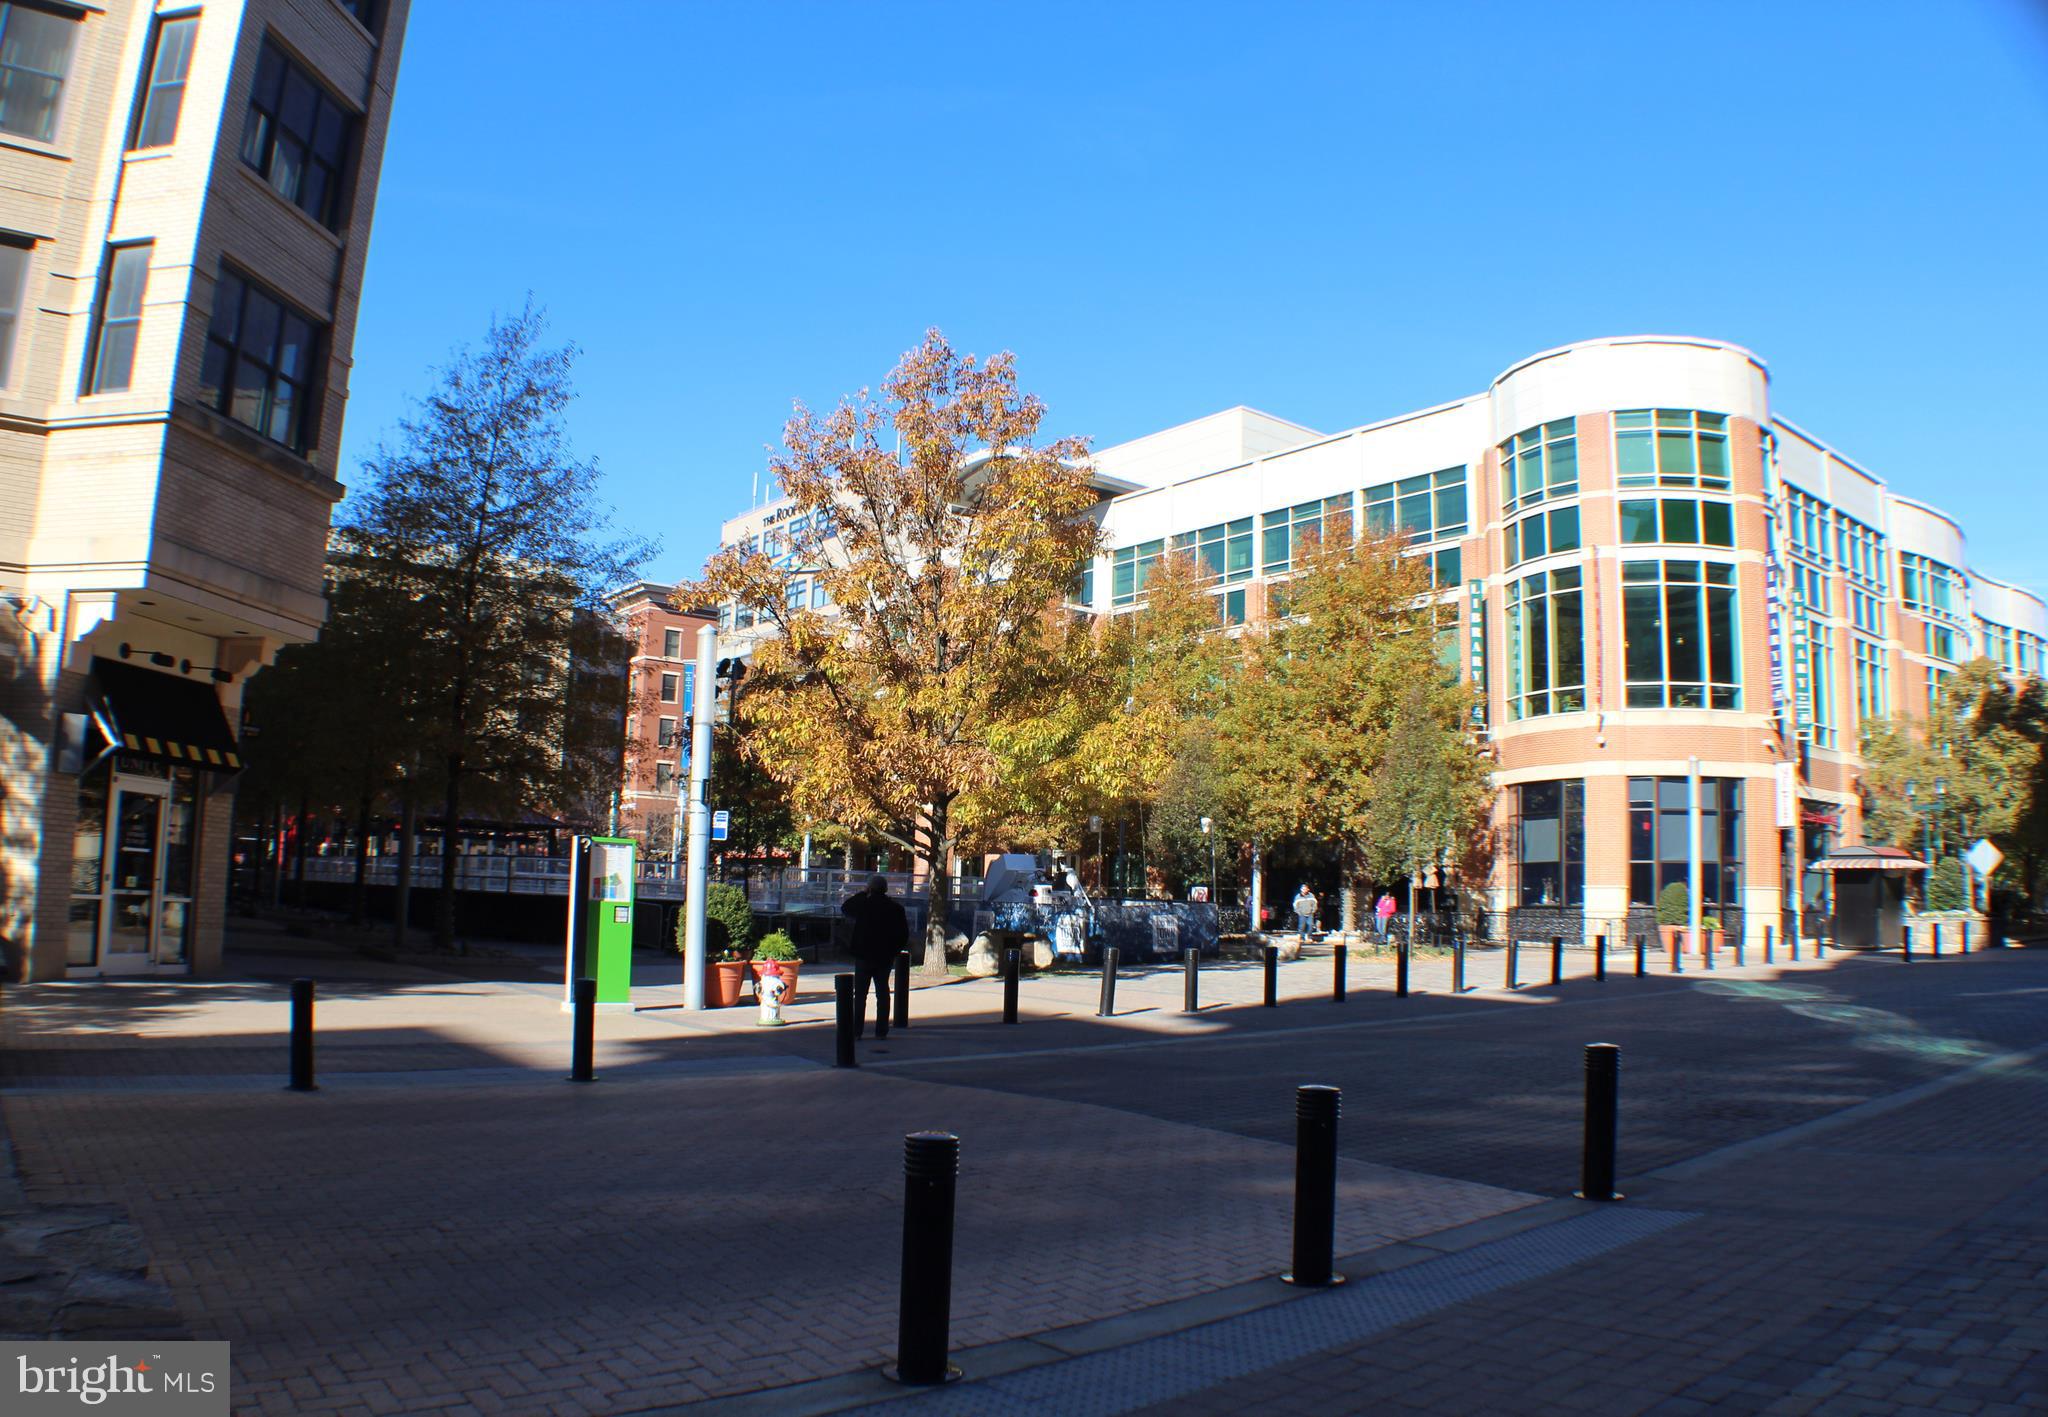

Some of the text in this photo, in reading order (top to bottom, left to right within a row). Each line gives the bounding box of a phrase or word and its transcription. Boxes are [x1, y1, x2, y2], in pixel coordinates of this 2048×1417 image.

[763, 514, 776, 527] THE
[1470, 583, 1483, 681] LIBRARY
[1792, 591, 1808, 688] LIBRARY
